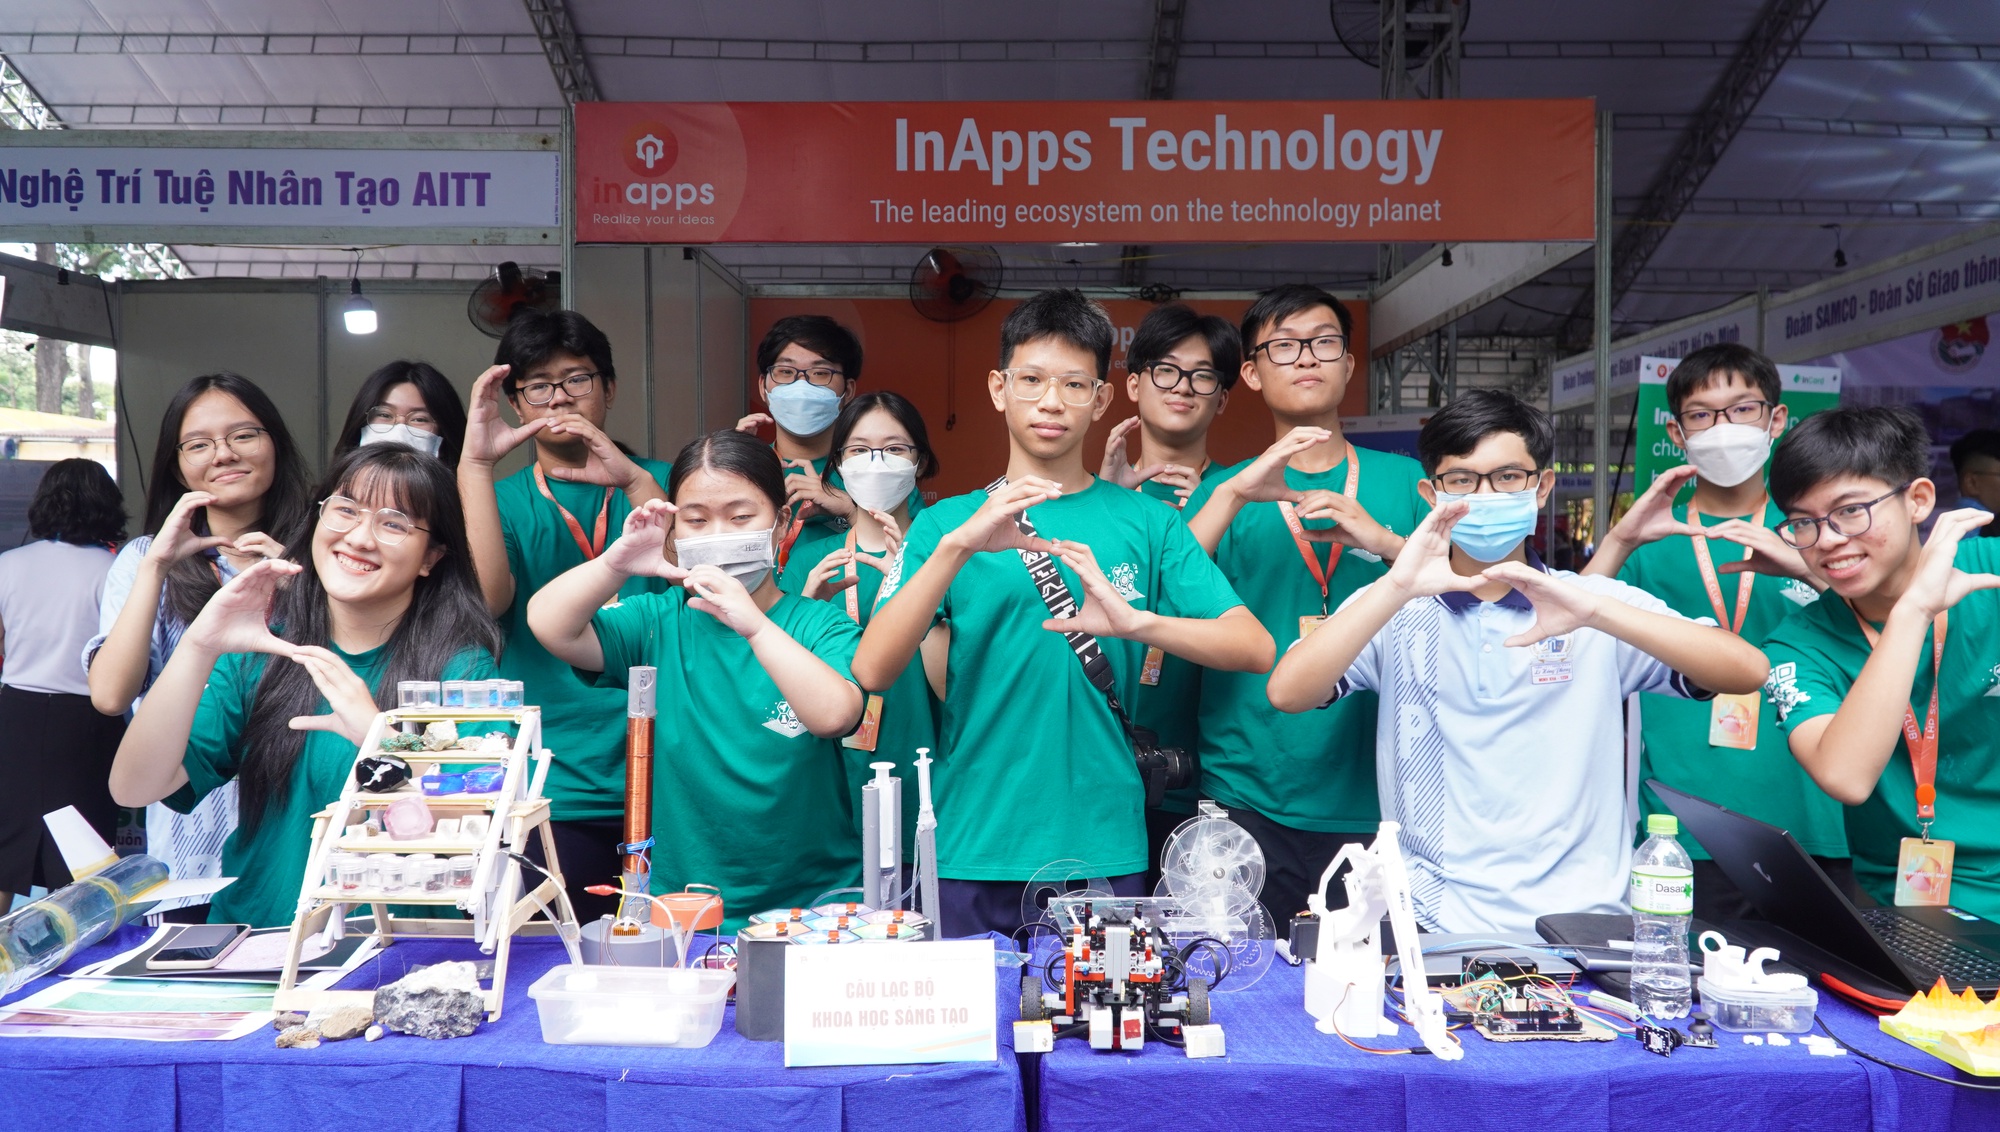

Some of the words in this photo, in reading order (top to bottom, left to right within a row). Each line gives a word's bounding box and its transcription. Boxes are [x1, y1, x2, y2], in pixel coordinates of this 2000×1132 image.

[895, 118, 1093, 186] InApps
[1109, 114, 1444, 186] Technology
[0, 168, 84, 211] Nghệ
[96, 168, 142, 205] Trí
[154, 169, 215, 212] Tuệ
[228, 169, 323, 206] Nhân
[334, 171, 400, 214] Tạo
[412, 172, 492, 207] AITT
[593, 177, 715, 211] inapps
[593, 213, 641, 225] Realize
[645, 215, 674, 226] your
[678, 213, 715, 225] ideas
[870, 200, 914, 224] The
[921, 199, 1007, 229] leading
[1014, 202, 1142, 229] ecosystem
[1150, 204, 1179, 222] on
[1186, 198, 1224, 222] the
[1230, 197, 1362, 228] technology
[1368, 197, 1442, 228] planet
[1786, 311, 1813, 339] Đoàn
[1816, 295, 1857, 330] SAMCO
[1869, 283, 1902, 315] Đoàn
[1928, 268, 1959, 298] Giao
[1286, 512, 1301, 534] CLUB
[1709, 583, 1721, 606] CLUB
[849, 602, 857, 617] LHP
[1904, 713, 1918, 740] CLUB
[1926, 718, 1935, 740] LHP
[845, 978, 875, 999] CÂU
[881, 980, 909, 1002] LẠC
[914, 976, 935, 1001] BỘ
[812, 1010, 853, 1029] KHOA
[858, 1009, 889, 1031] HỌC
[894, 1005, 935, 1026] SÁNG
[940, 1007, 969, 1028] TẠO
